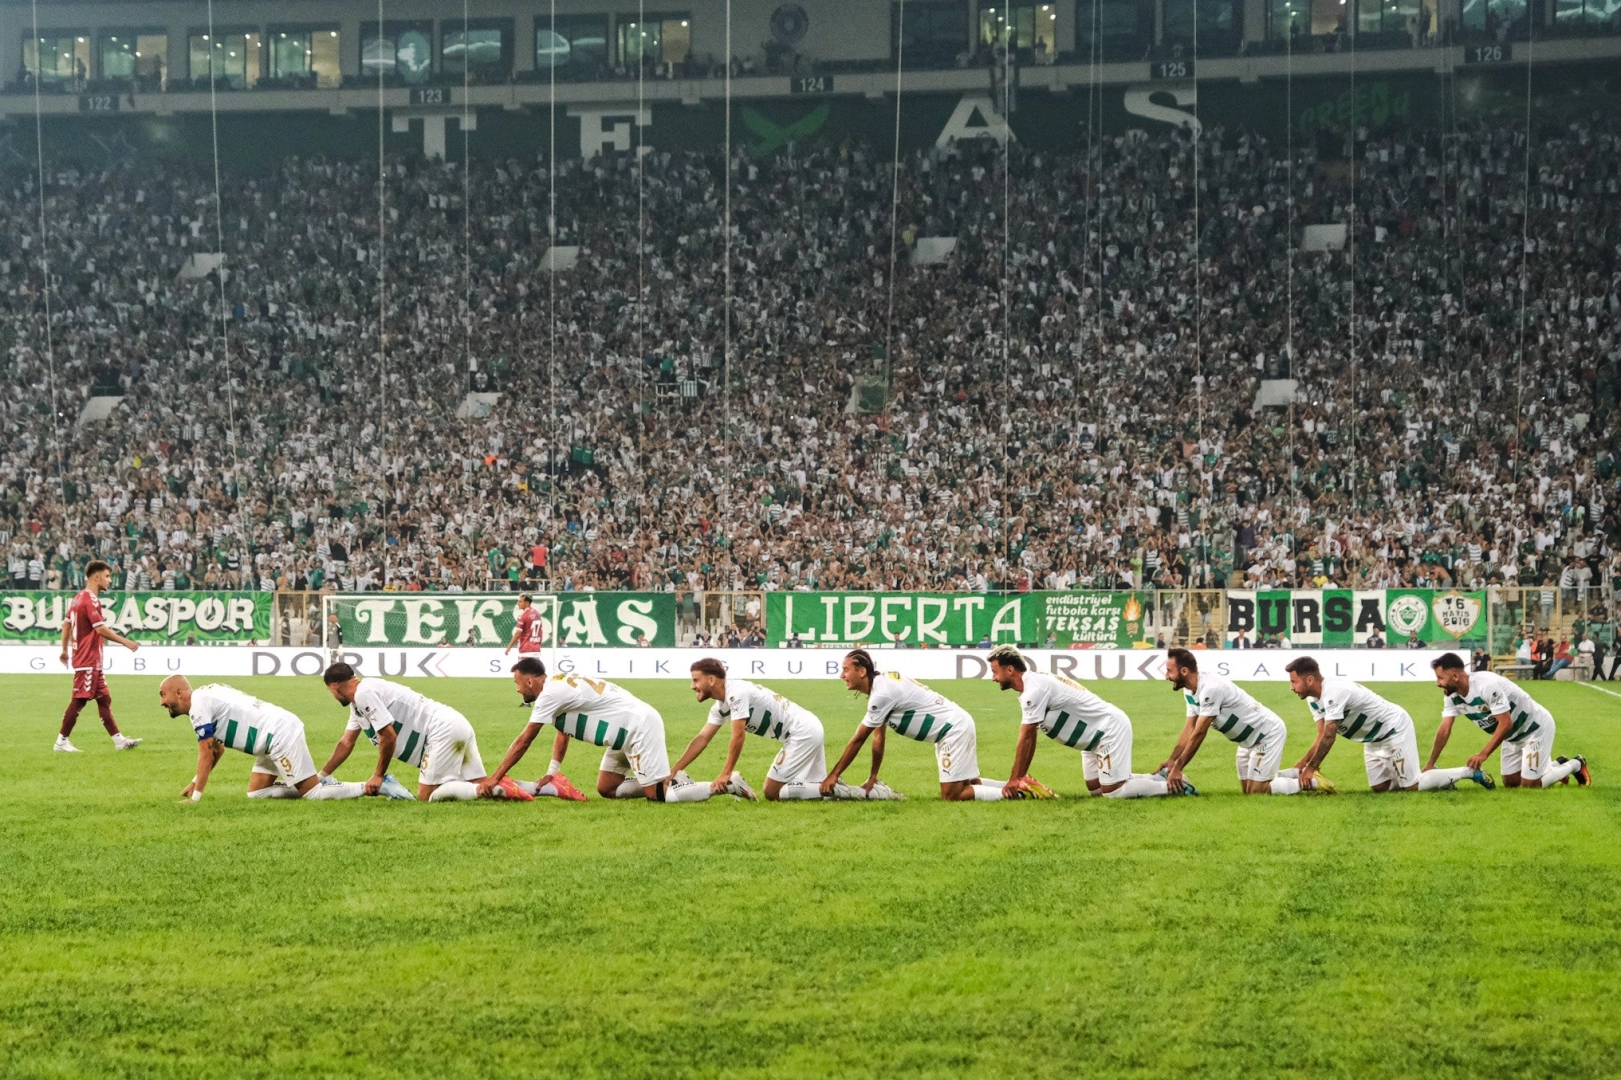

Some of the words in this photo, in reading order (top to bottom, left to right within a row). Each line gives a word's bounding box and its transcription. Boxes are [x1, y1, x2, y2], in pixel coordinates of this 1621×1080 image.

[1475, 46, 1503, 62] 126
[1160, 62, 1187, 77] 125
[798, 77, 826, 92] 124
[87, 95, 112, 111] 122
[418, 88, 444, 104] 123
[2, 596, 255, 636] BUSASPOR
[1046, 605, 1087, 615] futbola
[1091, 605, 1120, 615] karşı
[1228, 598, 1386, 633] BURSA
[784, 594, 1024, 644] LIBERTA
[1046, 616, 1119, 631] TEKSAS
[1072, 631, 1117, 641] kültürü
[29, 657, 182, 671] GUBU
[489, 655, 671, 674] SĞLIK
[1217, 662, 1417, 677] SALIK
[279, 756, 293, 773] 9
[1096, 753, 1112, 770] 61
[1526, 751, 1541, 768] 11
